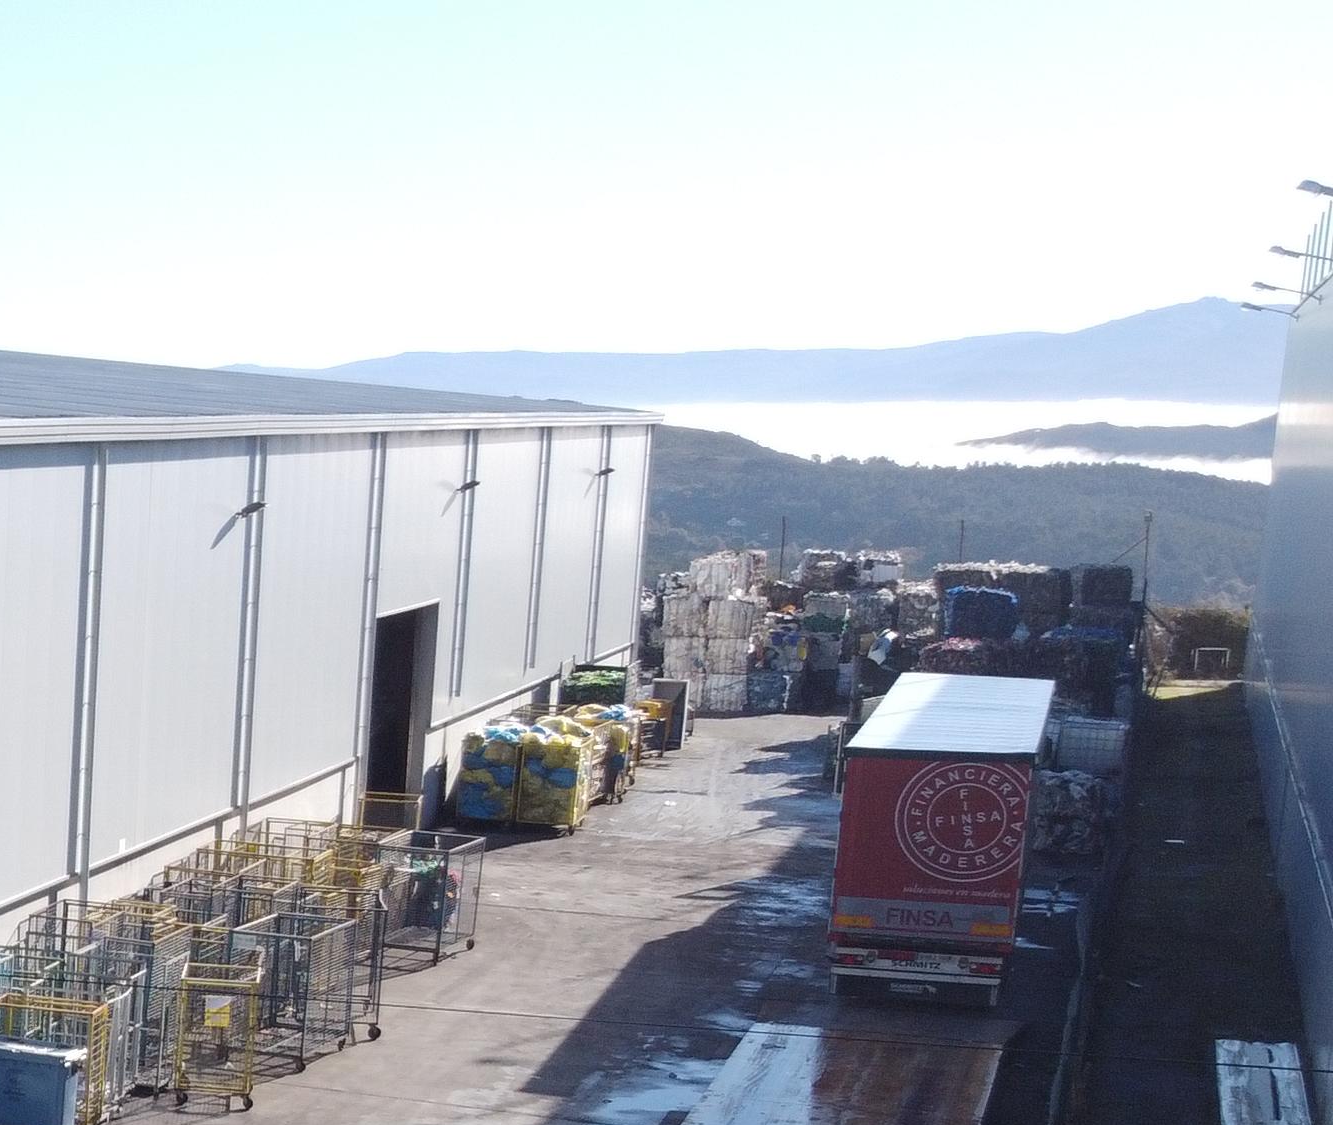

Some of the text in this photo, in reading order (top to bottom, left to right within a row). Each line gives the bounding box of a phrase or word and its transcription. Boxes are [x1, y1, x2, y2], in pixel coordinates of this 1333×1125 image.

[911, 768, 1021, 817] FINANCIERA
[935, 810, 1001, 827] FINSA
[912, 820, 1024, 868] MADERERA
[885, 907, 954, 928] FINSA
